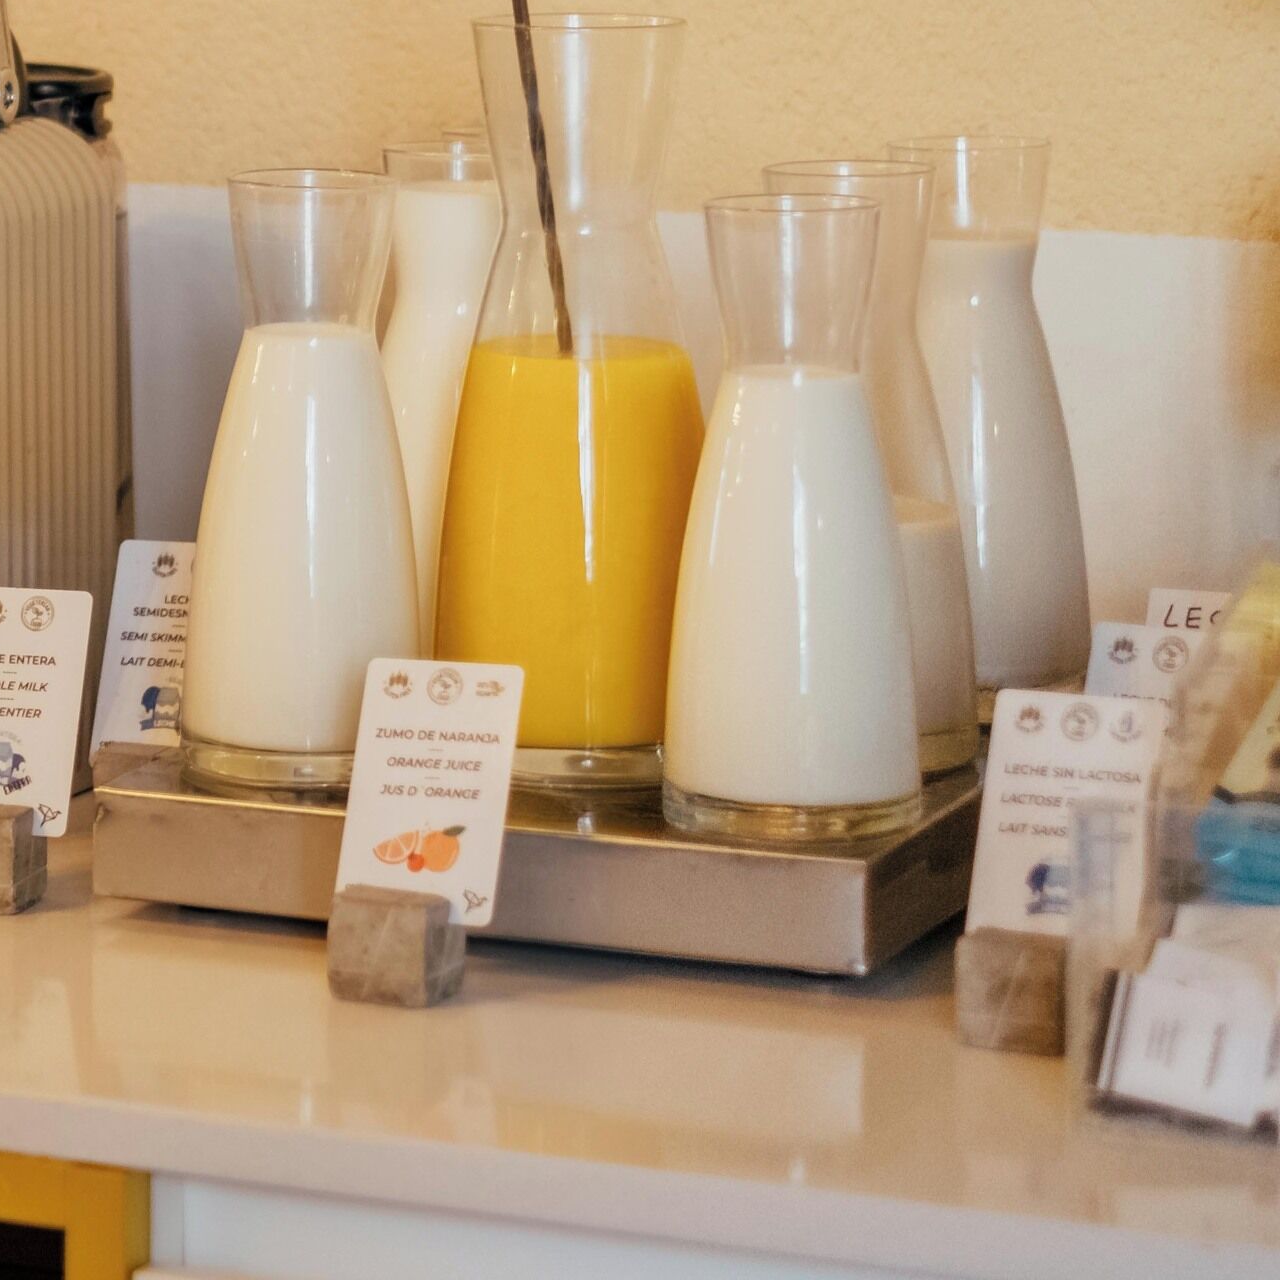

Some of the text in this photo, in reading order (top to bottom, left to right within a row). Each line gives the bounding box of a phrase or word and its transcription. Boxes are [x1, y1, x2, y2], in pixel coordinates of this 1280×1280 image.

[120, 631, 148, 641] SEMI
[8, 655, 57, 666] ENTERA
[120, 657, 146, 666] LAIT
[17, 682, 48, 692] MILK
[375, 728, 501, 744] ZUMO DE NARANJA
[386, 756, 483, 772] ORANGE JUICE
[1003, 763, 1142, 784] LECHE SIN LACTOSA
[380, 783, 405, 796] JUS
[1000, 793, 1063, 807] LACTOSE
[998, 822, 1067, 837] LAIT SANS
